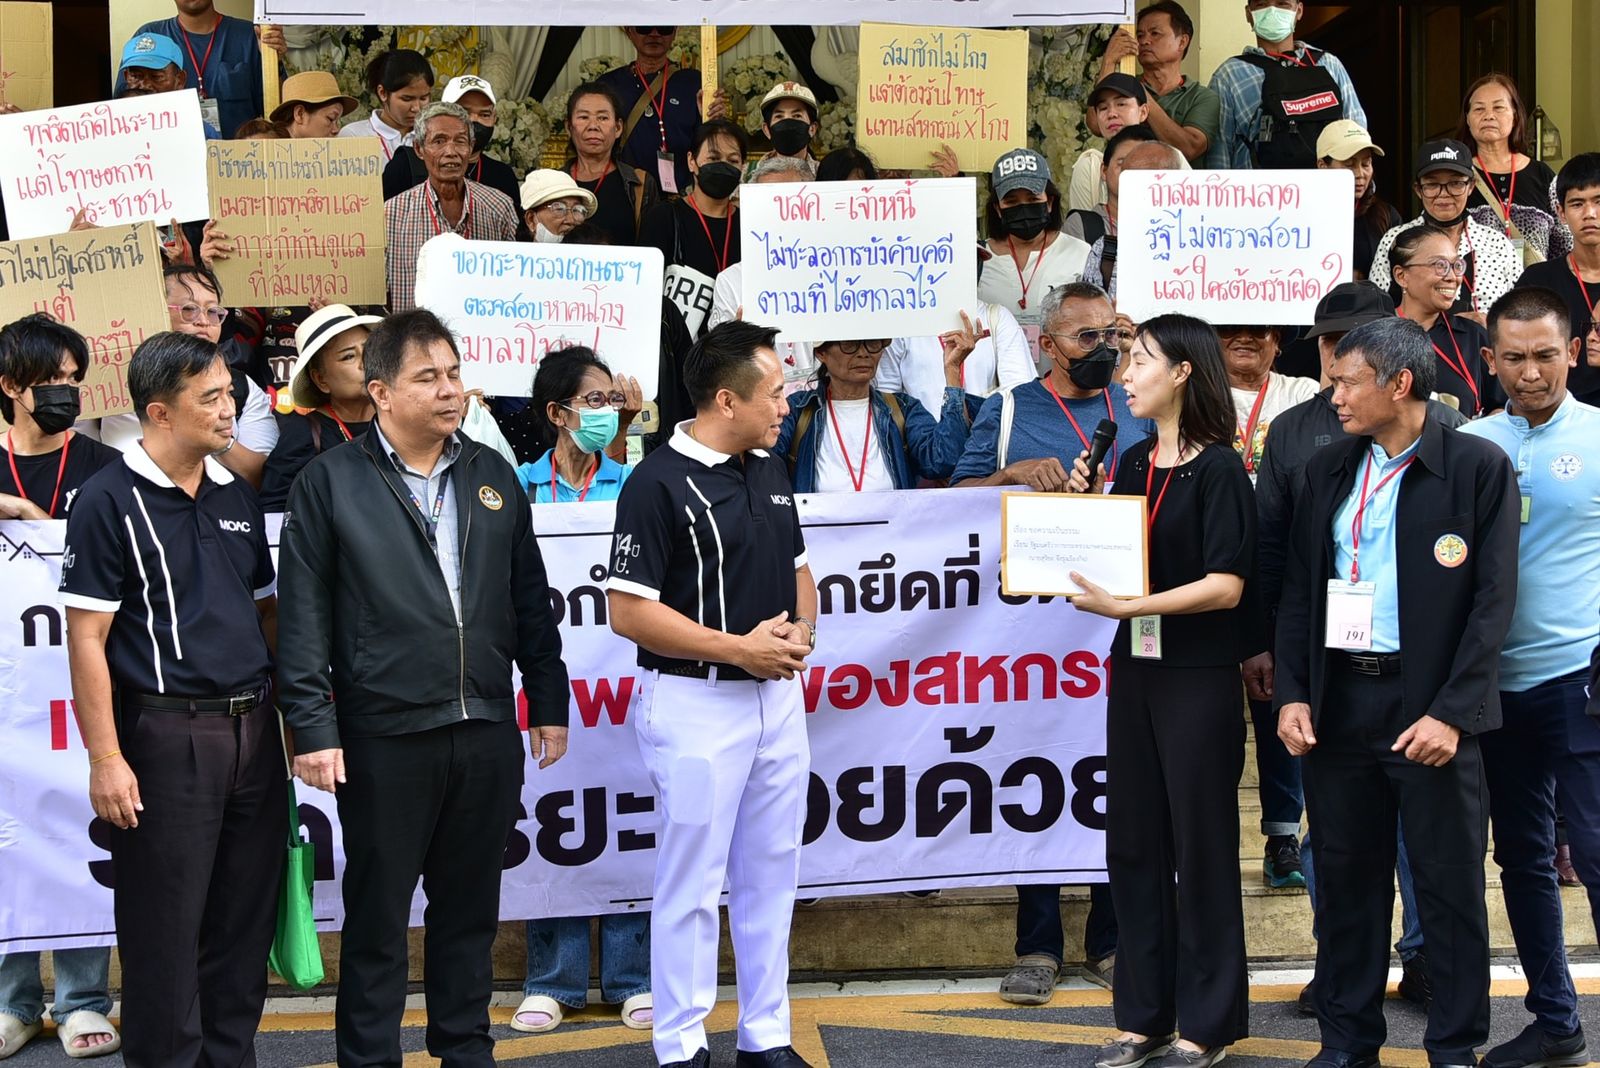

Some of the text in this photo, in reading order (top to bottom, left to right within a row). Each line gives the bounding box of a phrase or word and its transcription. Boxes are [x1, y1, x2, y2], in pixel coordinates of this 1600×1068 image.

[880, 33, 987, 70] สมาชิกไม่โกง
[869, 71, 985, 106] แต่ต้องรับโทษ
[1286, 95, 1332, 111] Supreme
[24, 105, 178, 157] ทุจริตเกิดในระบบ
[16, 143, 154, 200] แต่โทษตกที่
[998, 155, 1038, 177] 1985
[1430, 152, 1459, 161] PUMA
[233, 227, 366, 269] การกำกับดูแล
[751, 231, 954, 271] ไม่ชะลอการบังคับคดี
[1145, 208, 1311, 261] รัฐไม่ตรวจสอบ
[758, 265, 948, 315] ตามที่ได้ตกลงไว้
[219, 519, 251, 533] MOAC
[817, 533, 981, 615] กยึดที่
[1144, 643, 1154, 652] 20
[1345, 630, 1365, 641] 191
[799, 650, 1110, 713] องสหกร
